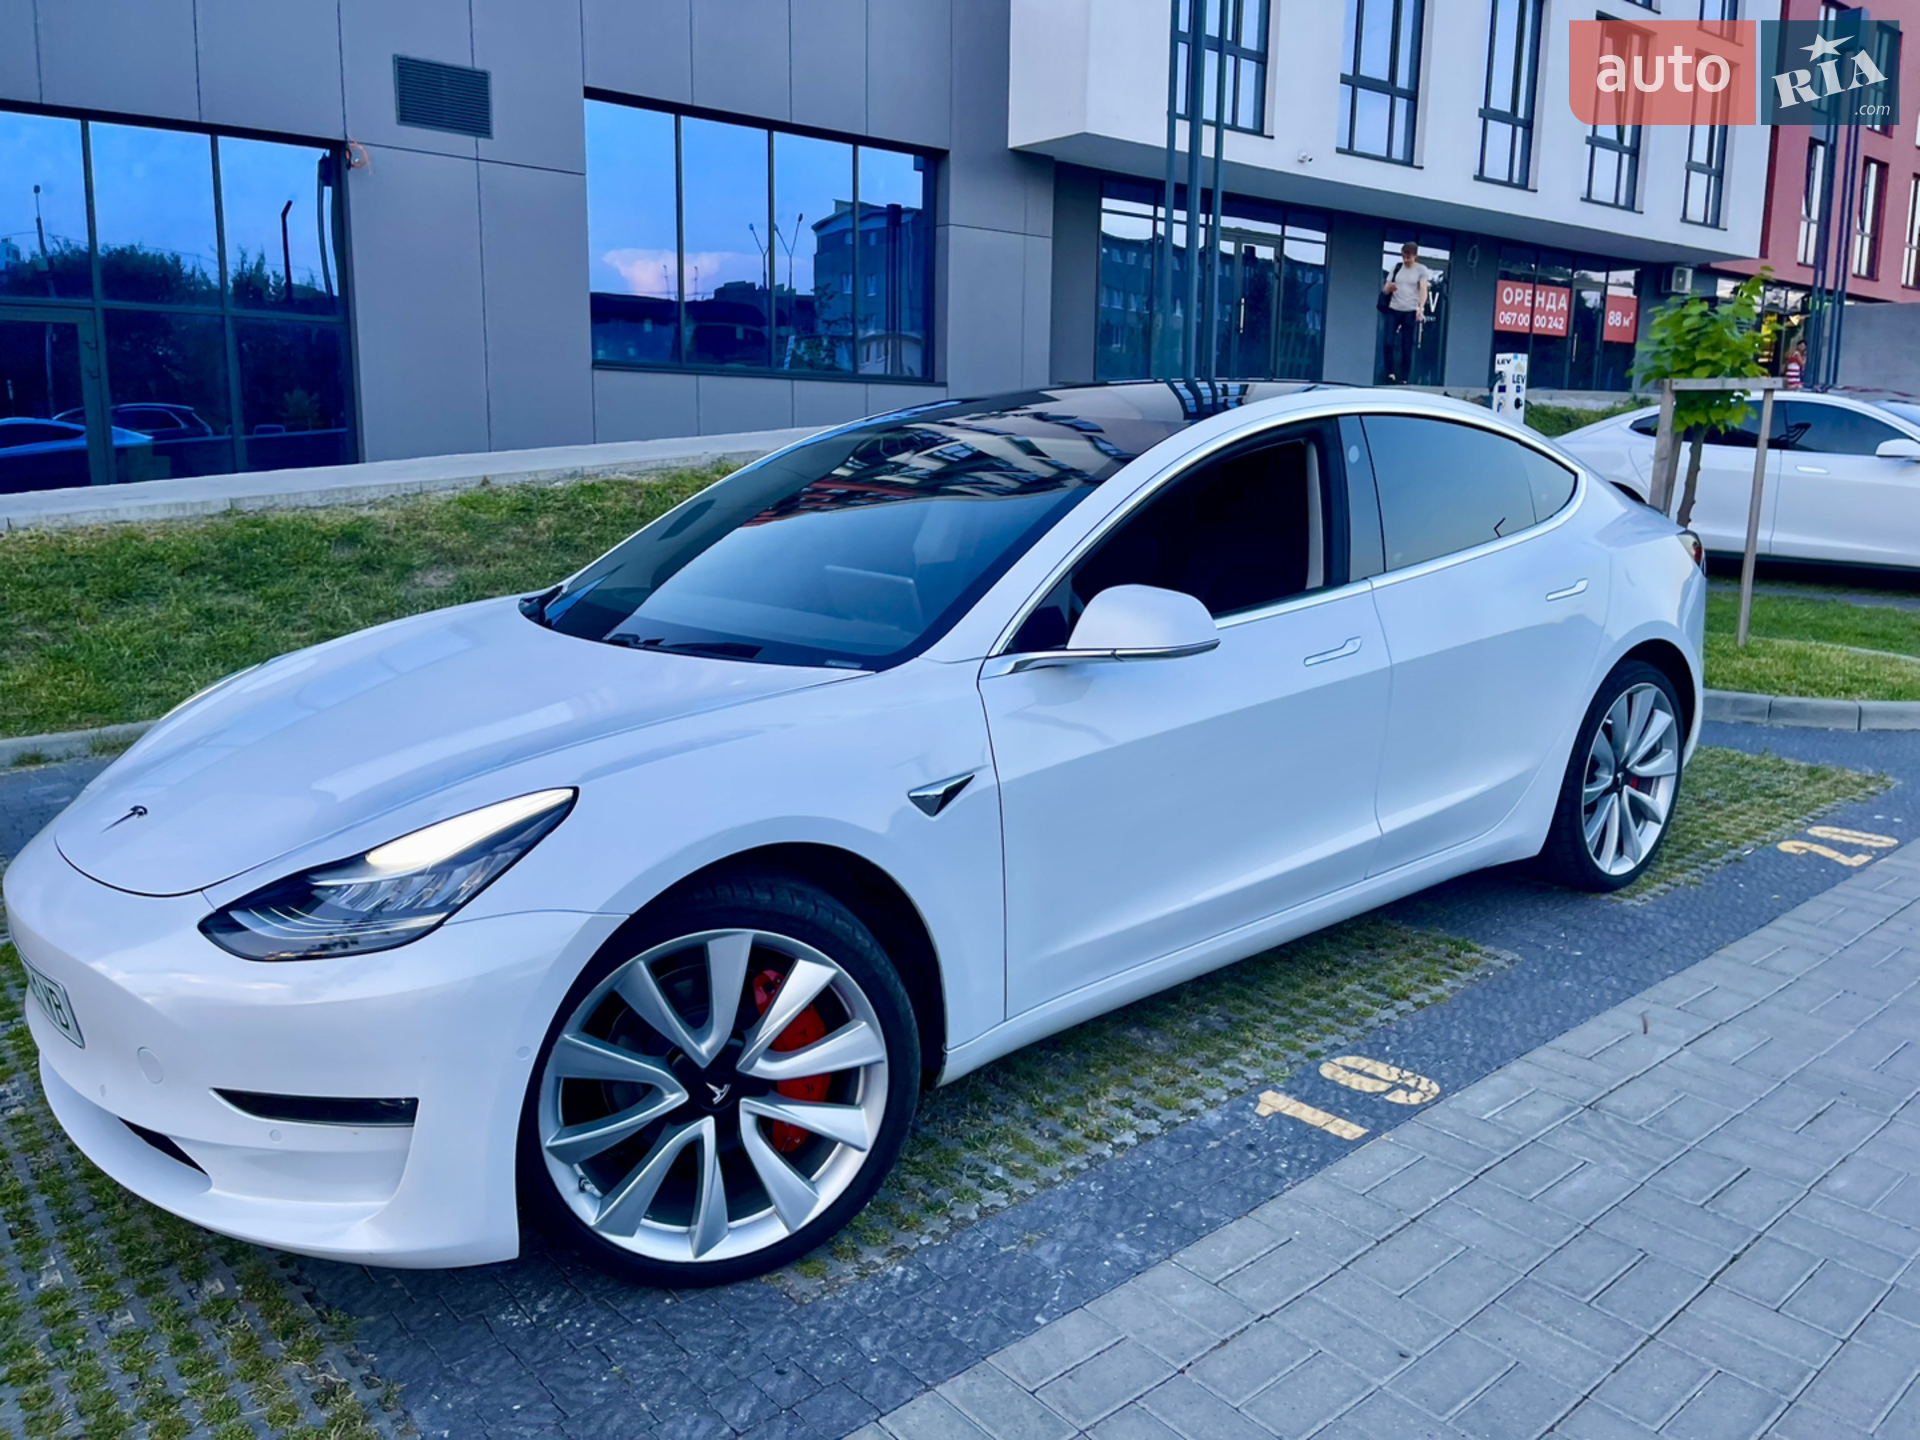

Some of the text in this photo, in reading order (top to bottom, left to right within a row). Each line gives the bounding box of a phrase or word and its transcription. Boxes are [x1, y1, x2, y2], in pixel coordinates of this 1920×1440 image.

[1503, 287, 1568, 313] ОРЕНДА
[1499, 311, 1565, 330] 067 00 00 242
[1608, 310, 1622, 327] 88
[1512, 374, 1526, 384] LEV
[1776, 826, 1899, 867] 20
[1254, 1055, 1441, 1141] 19
